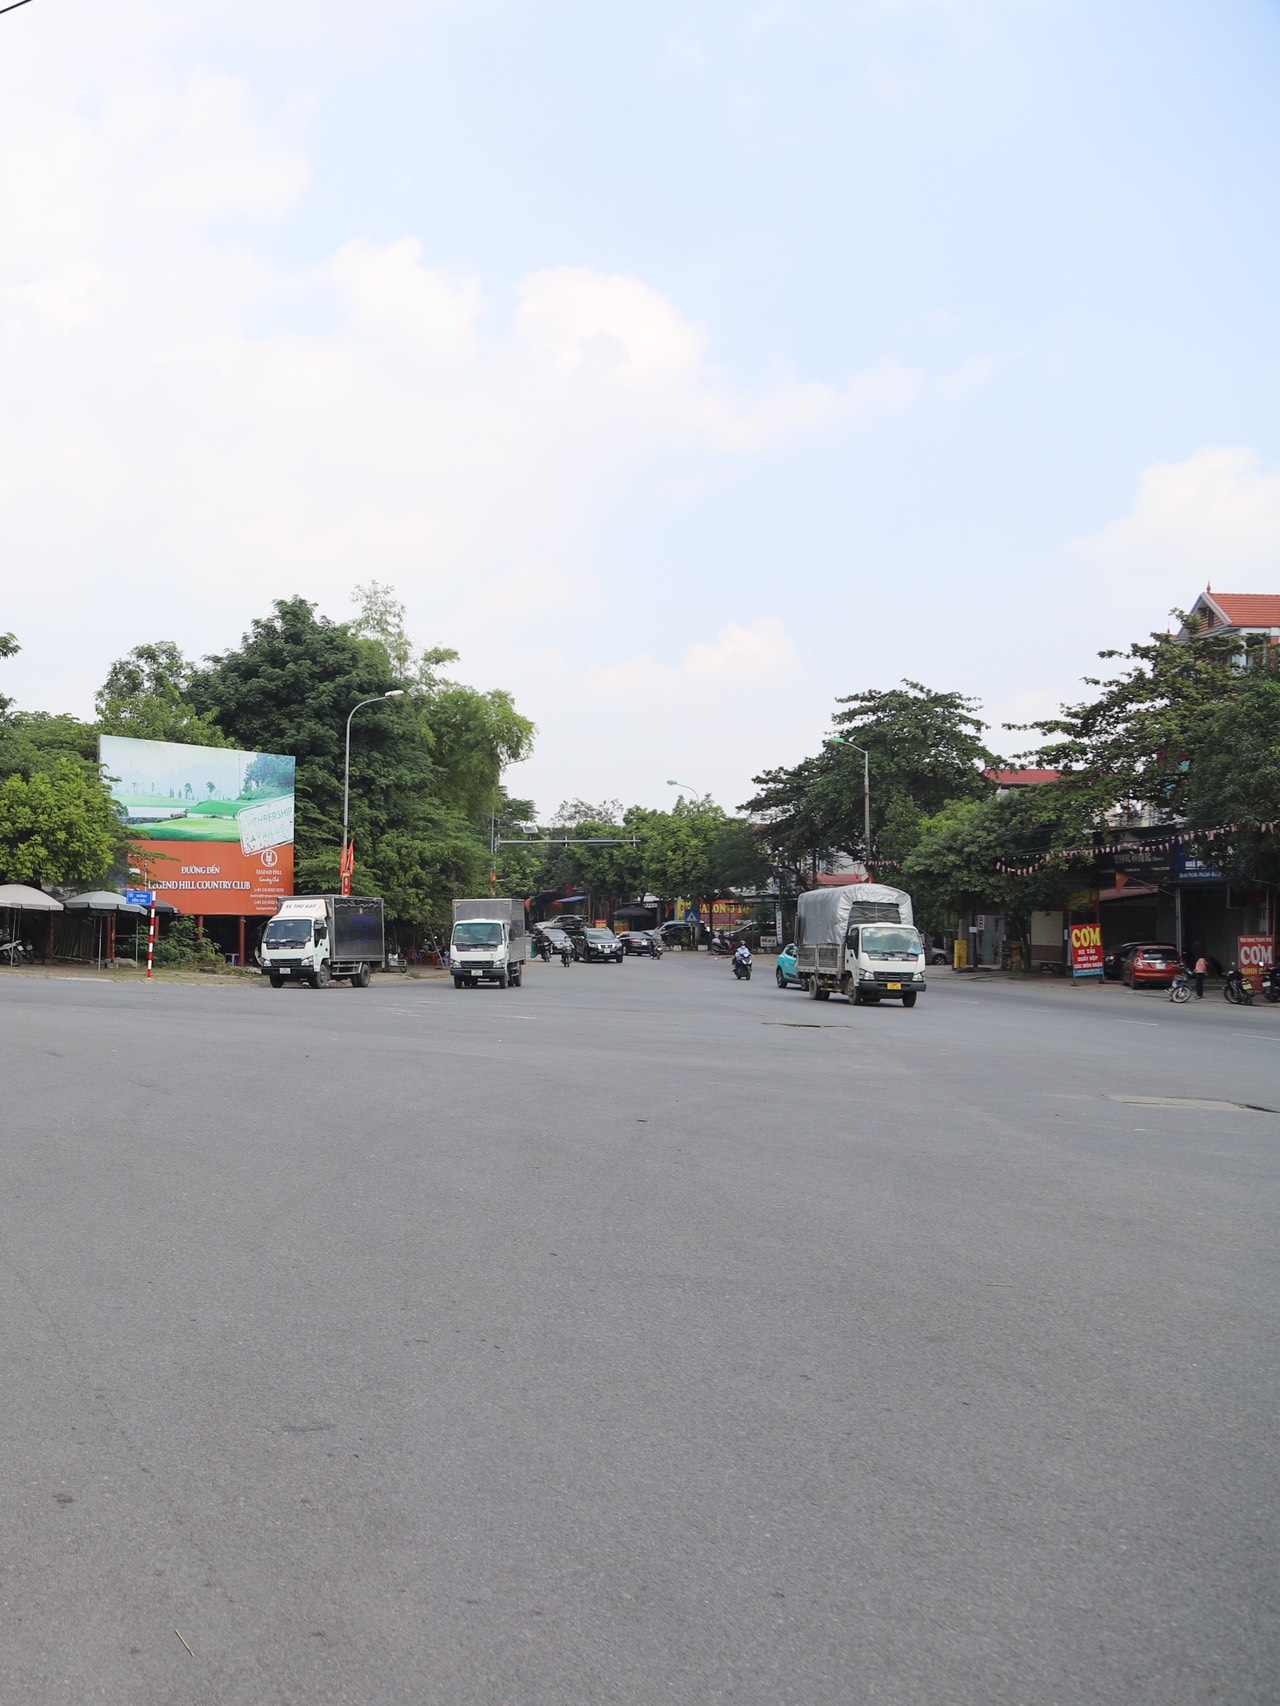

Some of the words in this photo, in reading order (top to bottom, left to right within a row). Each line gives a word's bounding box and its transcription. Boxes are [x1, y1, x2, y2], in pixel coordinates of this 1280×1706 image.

[181, 865, 206, 875] ĐƯỜNG
[206, 864, 220, 875] ĐẾN
[148, 881, 178, 890] LEGEND
[179, 881, 196, 890] HILL
[196, 881, 233, 890] COUNTRY
[232, 881, 251, 890] CLUB
[1072, 926, 1101, 948] CƠM
[1240, 944, 1273, 965] CƠM
